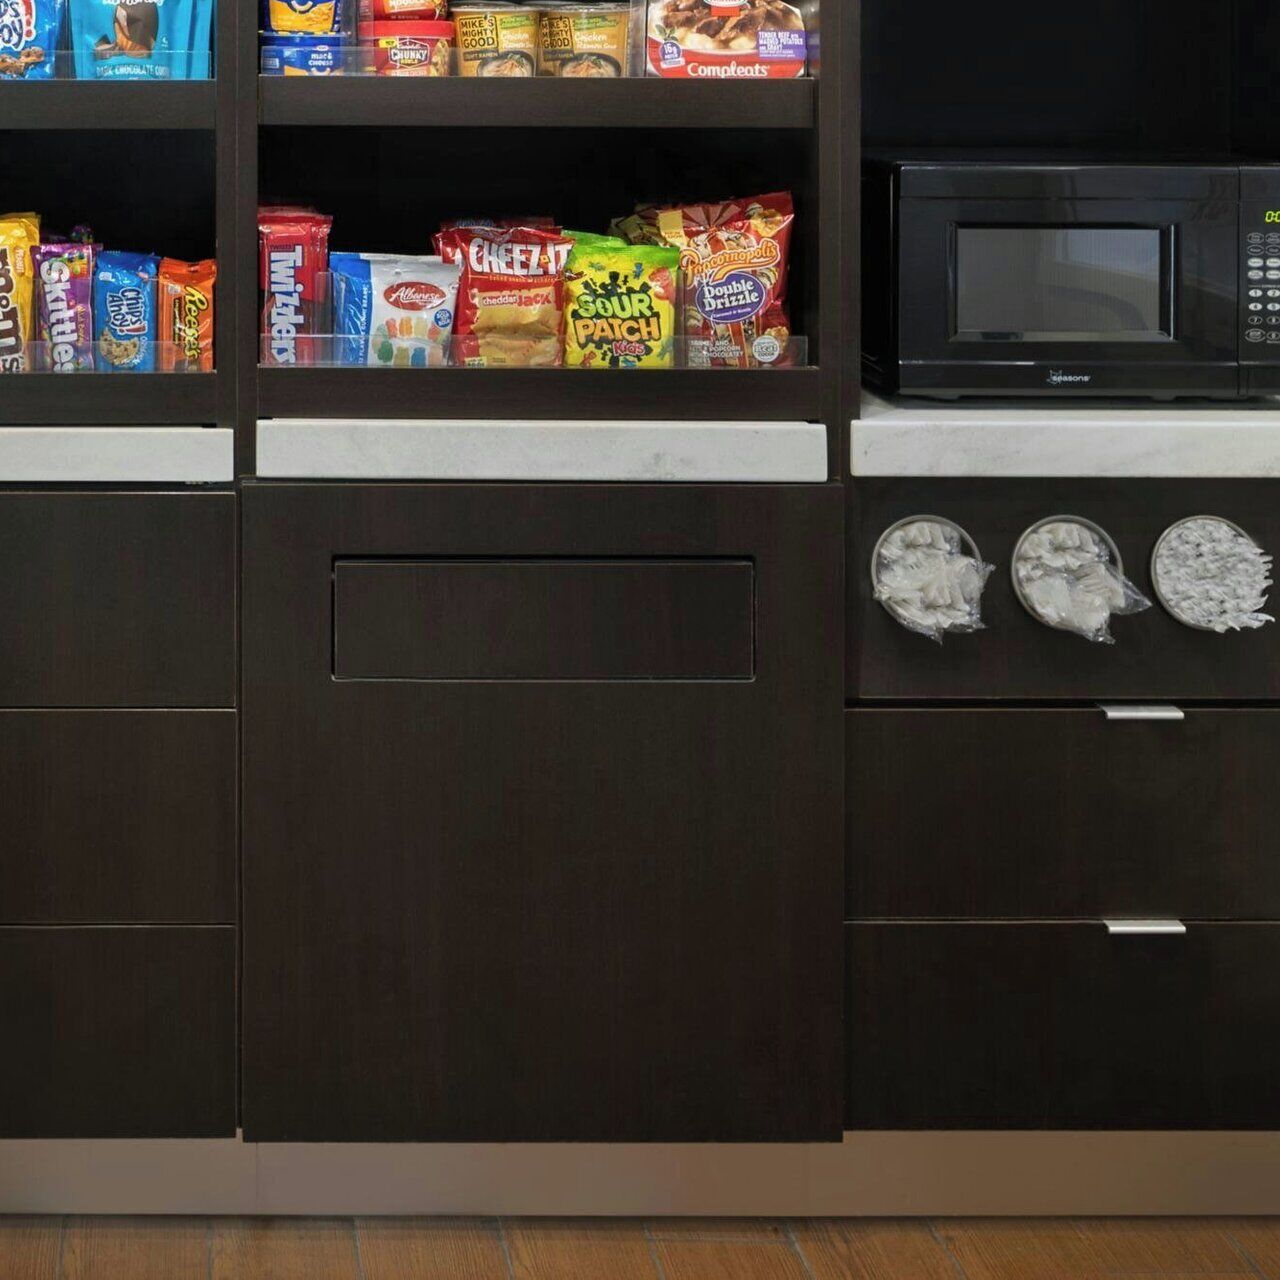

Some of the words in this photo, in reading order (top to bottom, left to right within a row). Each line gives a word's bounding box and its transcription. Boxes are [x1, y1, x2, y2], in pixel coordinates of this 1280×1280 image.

[461, 19, 494, 30] MIKE'S
[462, 29, 495, 38] MIGHTY
[463, 37, 495, 49] GOOD
[542, 37, 570, 50] GOOD
[391, 49, 428, 61] CHUNKY
[687, 61, 768, 77] Compleats
[469, 237, 573, 276] CHEEZ-IT
[680, 238, 780, 287] Popcornopolis
[389, 285, 446, 304] Albanese
[703, 280, 755, 298] Double
[120, 287, 144, 328] Chips
[482, 295, 518, 306] cheddar
[577, 293, 653, 318] SOUR
[703, 289, 761, 312] Drizzle
[39, 261, 78, 373] Skittles
[184, 285, 210, 359] Reese's
[573, 316, 661, 350] PATCH
[613, 340, 646, 357] Kids
